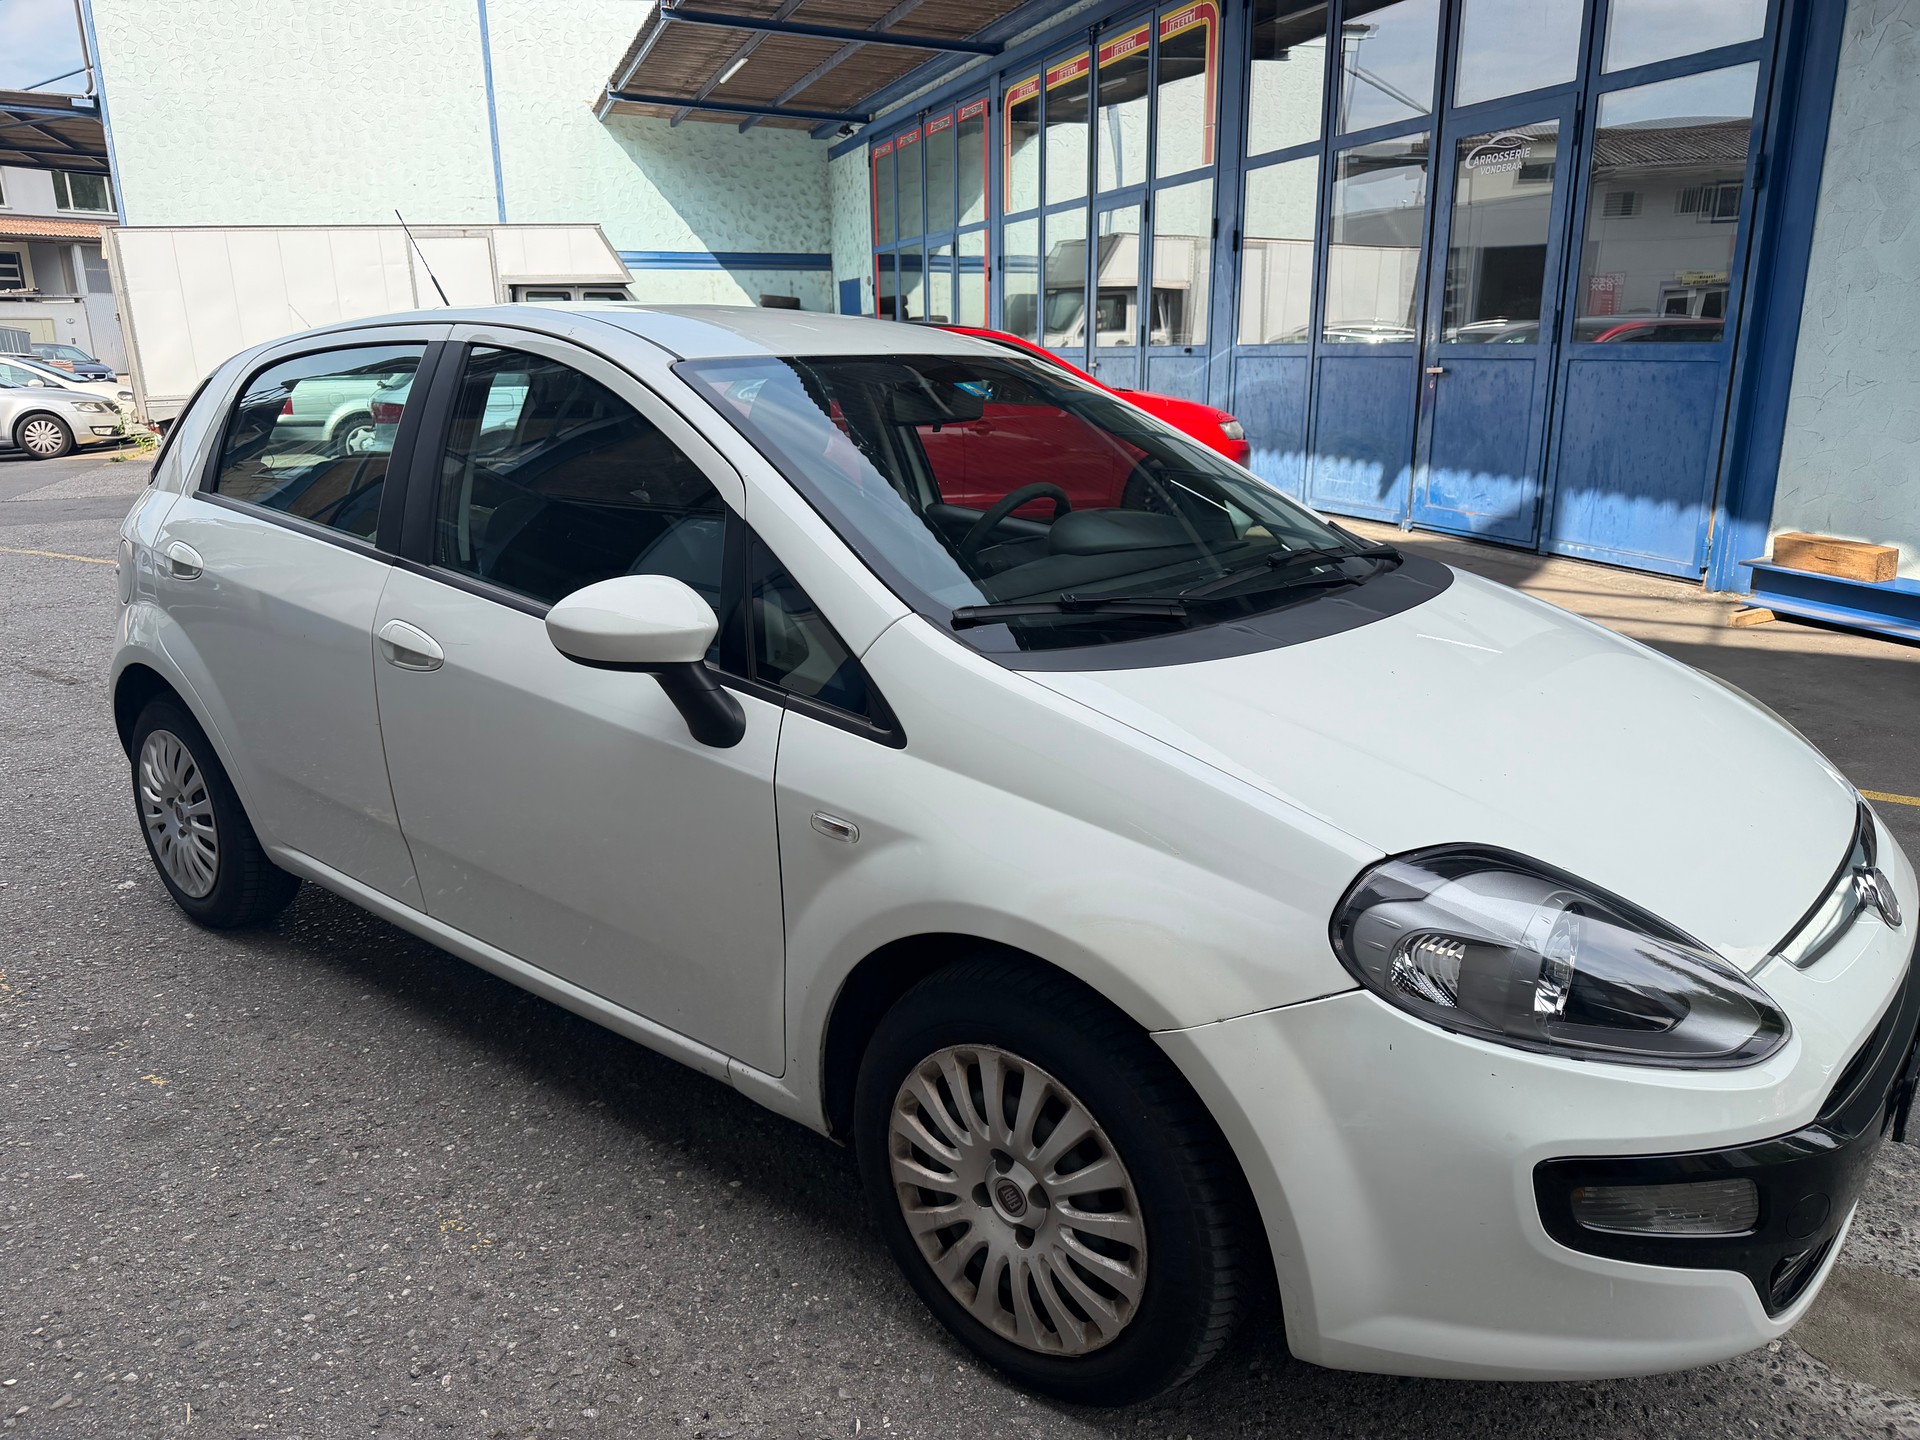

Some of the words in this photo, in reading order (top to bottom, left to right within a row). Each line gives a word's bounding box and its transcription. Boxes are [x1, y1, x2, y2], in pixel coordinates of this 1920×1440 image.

[1166, 8, 1195, 33] PIRELLI
[1112, 35, 1136, 57] PIRELLI
[1057, 62, 1078, 81] PIRELLI
[1465, 145, 1531, 169] CARROSSERIE
[1480, 162, 1523, 175] VONDERAA
[1001, 1187, 1021, 1210] FIAT
